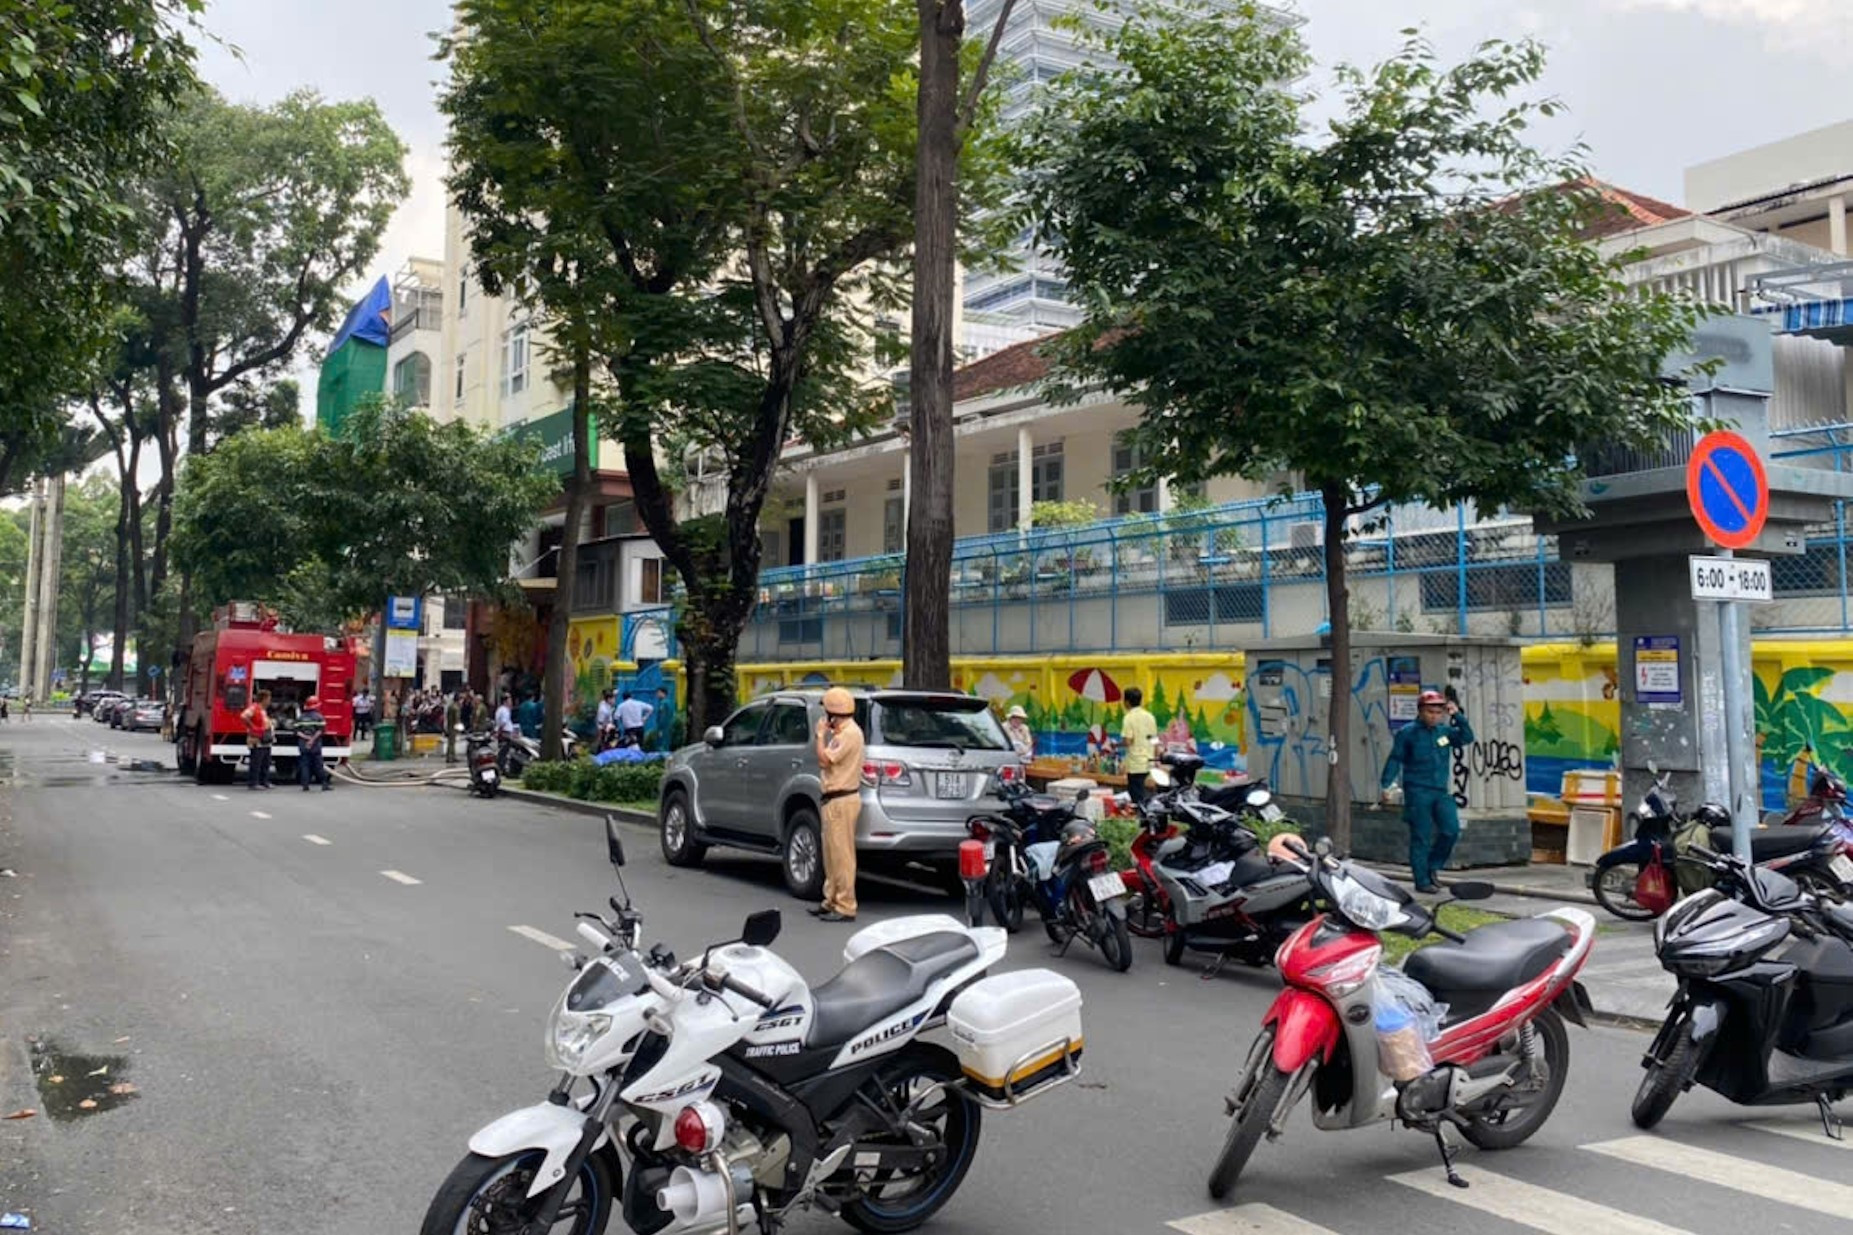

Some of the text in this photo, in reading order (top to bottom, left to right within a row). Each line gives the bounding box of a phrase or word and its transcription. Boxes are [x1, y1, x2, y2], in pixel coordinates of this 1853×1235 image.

[1697, 567, 1725, 588] 6:00
[1739, 570, 1766, 591] 18:00
[753, 1016, 804, 1032] CSGT
[850, 1018, 911, 1055] POLICE
[745, 1042, 800, 1058] TRAFFIC POLICE
[634, 1072, 712, 1103] CSGT
